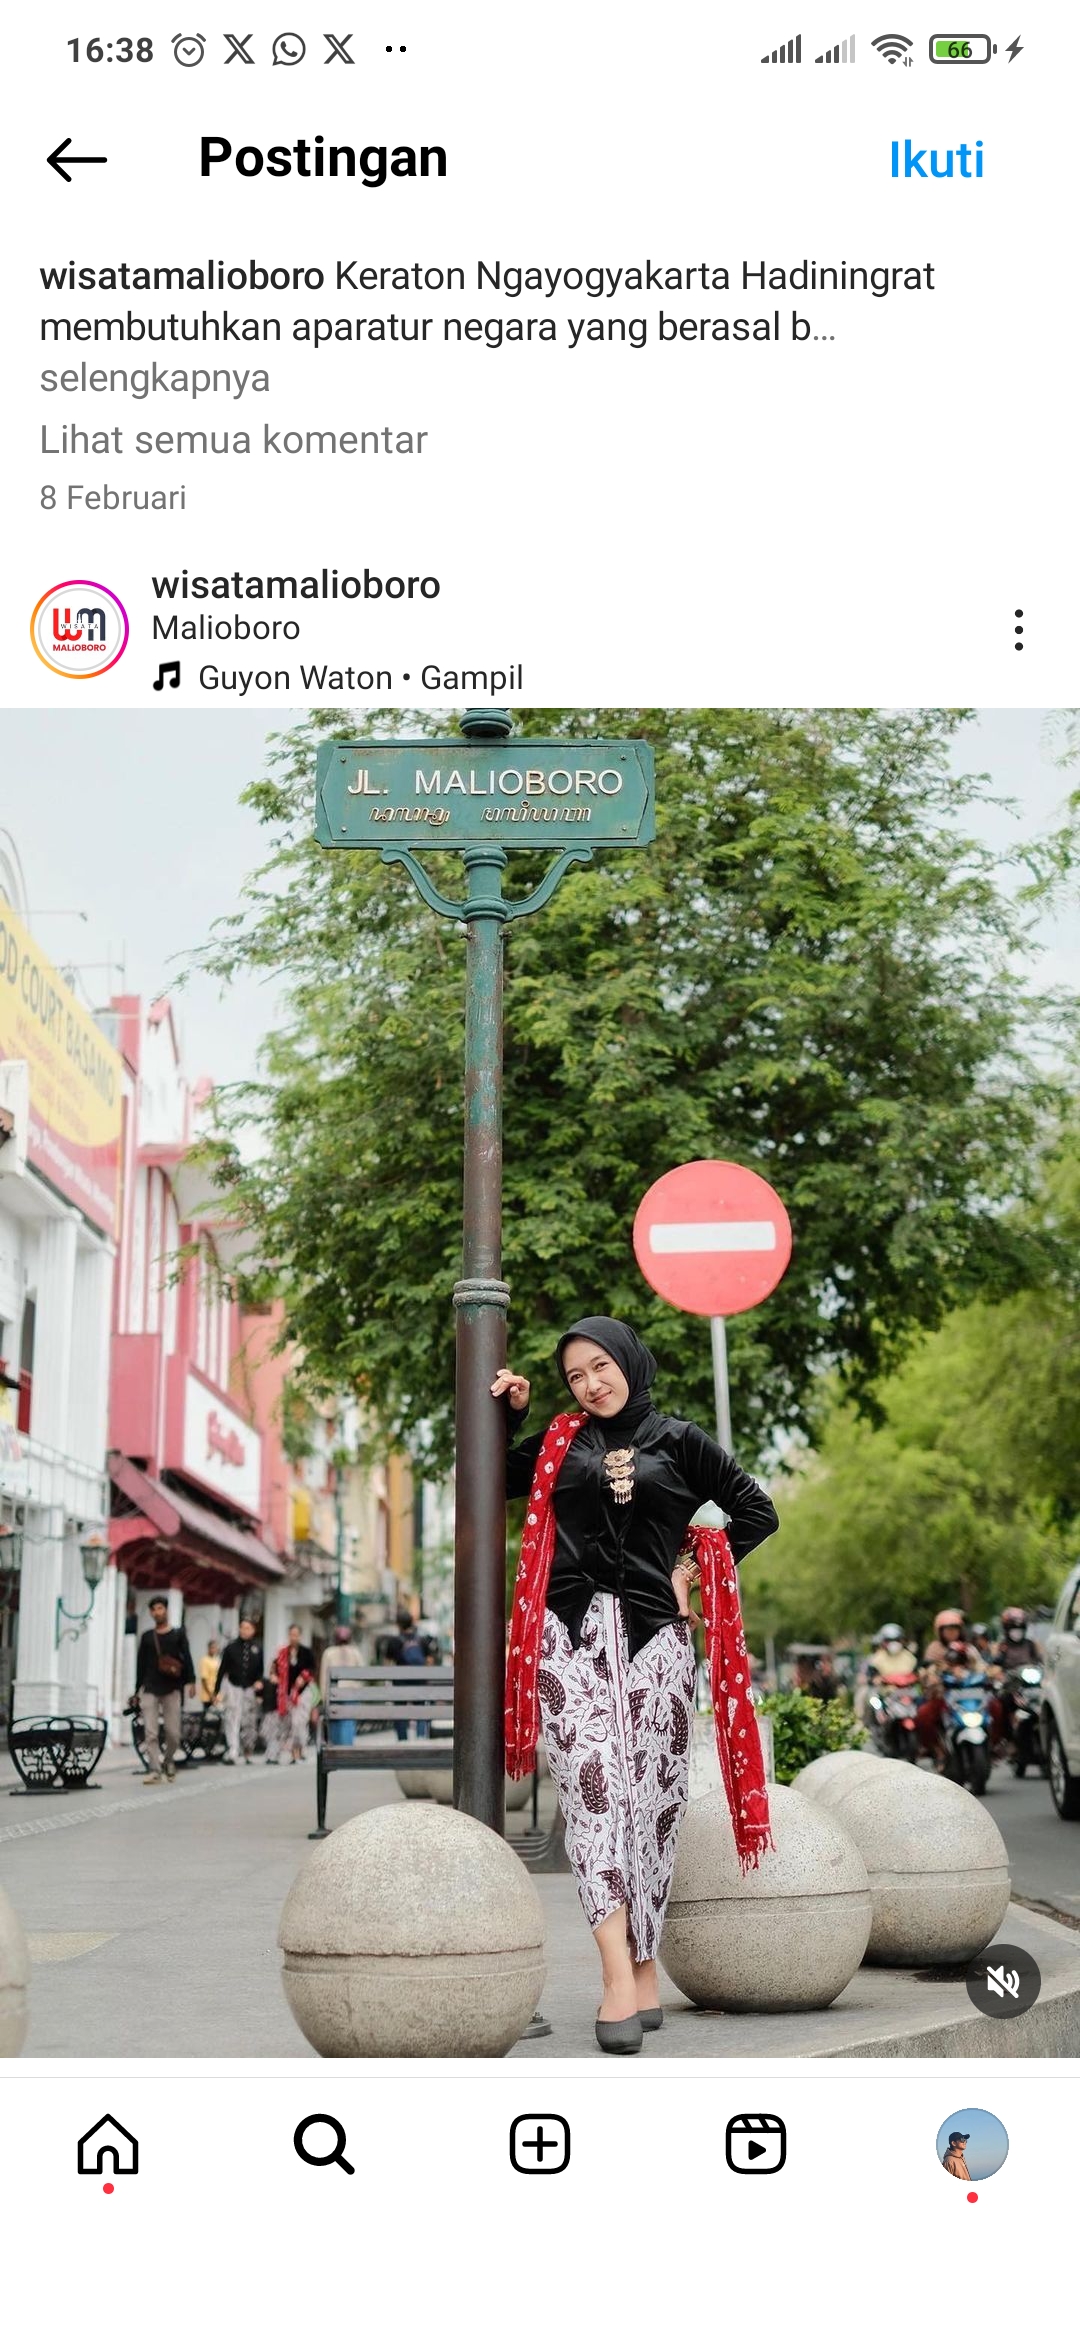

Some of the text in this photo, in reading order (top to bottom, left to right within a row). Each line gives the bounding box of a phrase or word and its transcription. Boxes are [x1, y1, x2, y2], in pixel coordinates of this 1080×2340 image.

[68, 37, 153, 62] 16:38
[947, 41, 973, 59] 66
[201, 135, 446, 188] Postingan
[891, 139, 984, 179] Ikuti
[40, 260, 935, 298] wisatamalioboro Keraton Ngayogyakarta Hadiningrat
[41, 311, 280, 342] membutuhkan
[293, 314, 433, 349] aparatur
[444, 319, 556, 349] negara
[568, 319, 646, 349] yang
[659, 311, 779, 342] berasal
[41, 362, 270, 400] selengkapnya
[41, 424, 429, 454] Lihat semua komentar
[40, 484, 186, 510] 8 Februari
[151, 568, 440, 600] wisatamalioboro
[153, 613, 300, 640] Malioboro
[200, 663, 523, 697] Guyon Waton Gampil
[347, 769, 624, 796] JL. MALIOBORO
[21, 954, 64, 1044] COURT
